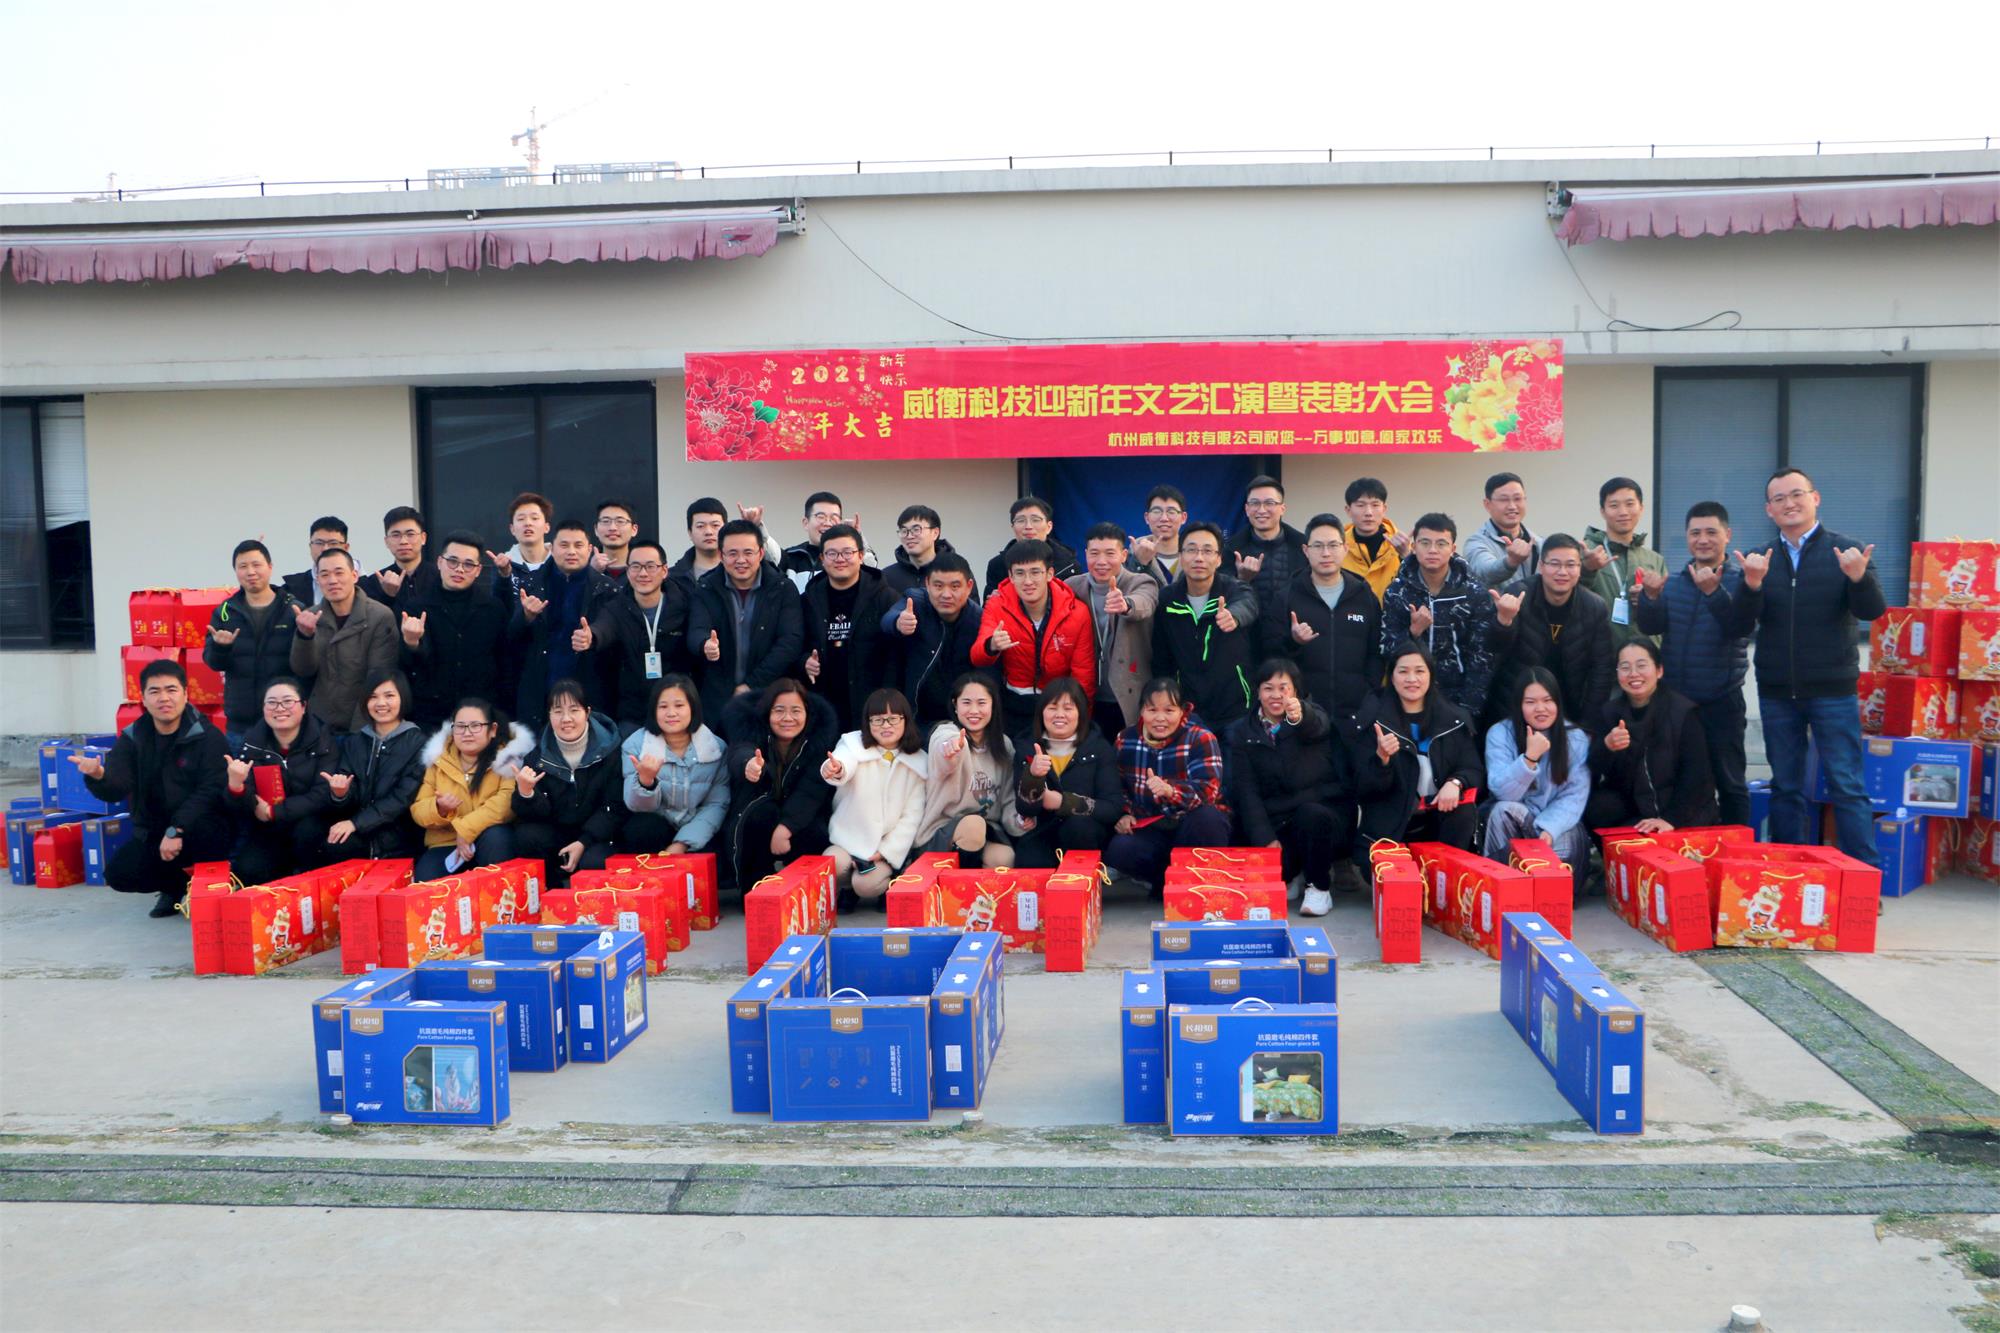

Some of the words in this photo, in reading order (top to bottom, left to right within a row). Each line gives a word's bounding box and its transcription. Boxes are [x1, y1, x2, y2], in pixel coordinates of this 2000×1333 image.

[880, 353, 907, 368] 新年
[792, 365, 866, 385] 2021
[880, 373, 908, 387] 快乐
[903, 381, 1433, 419] 威衡科技迎新年文艺汇演暨表彰大会
